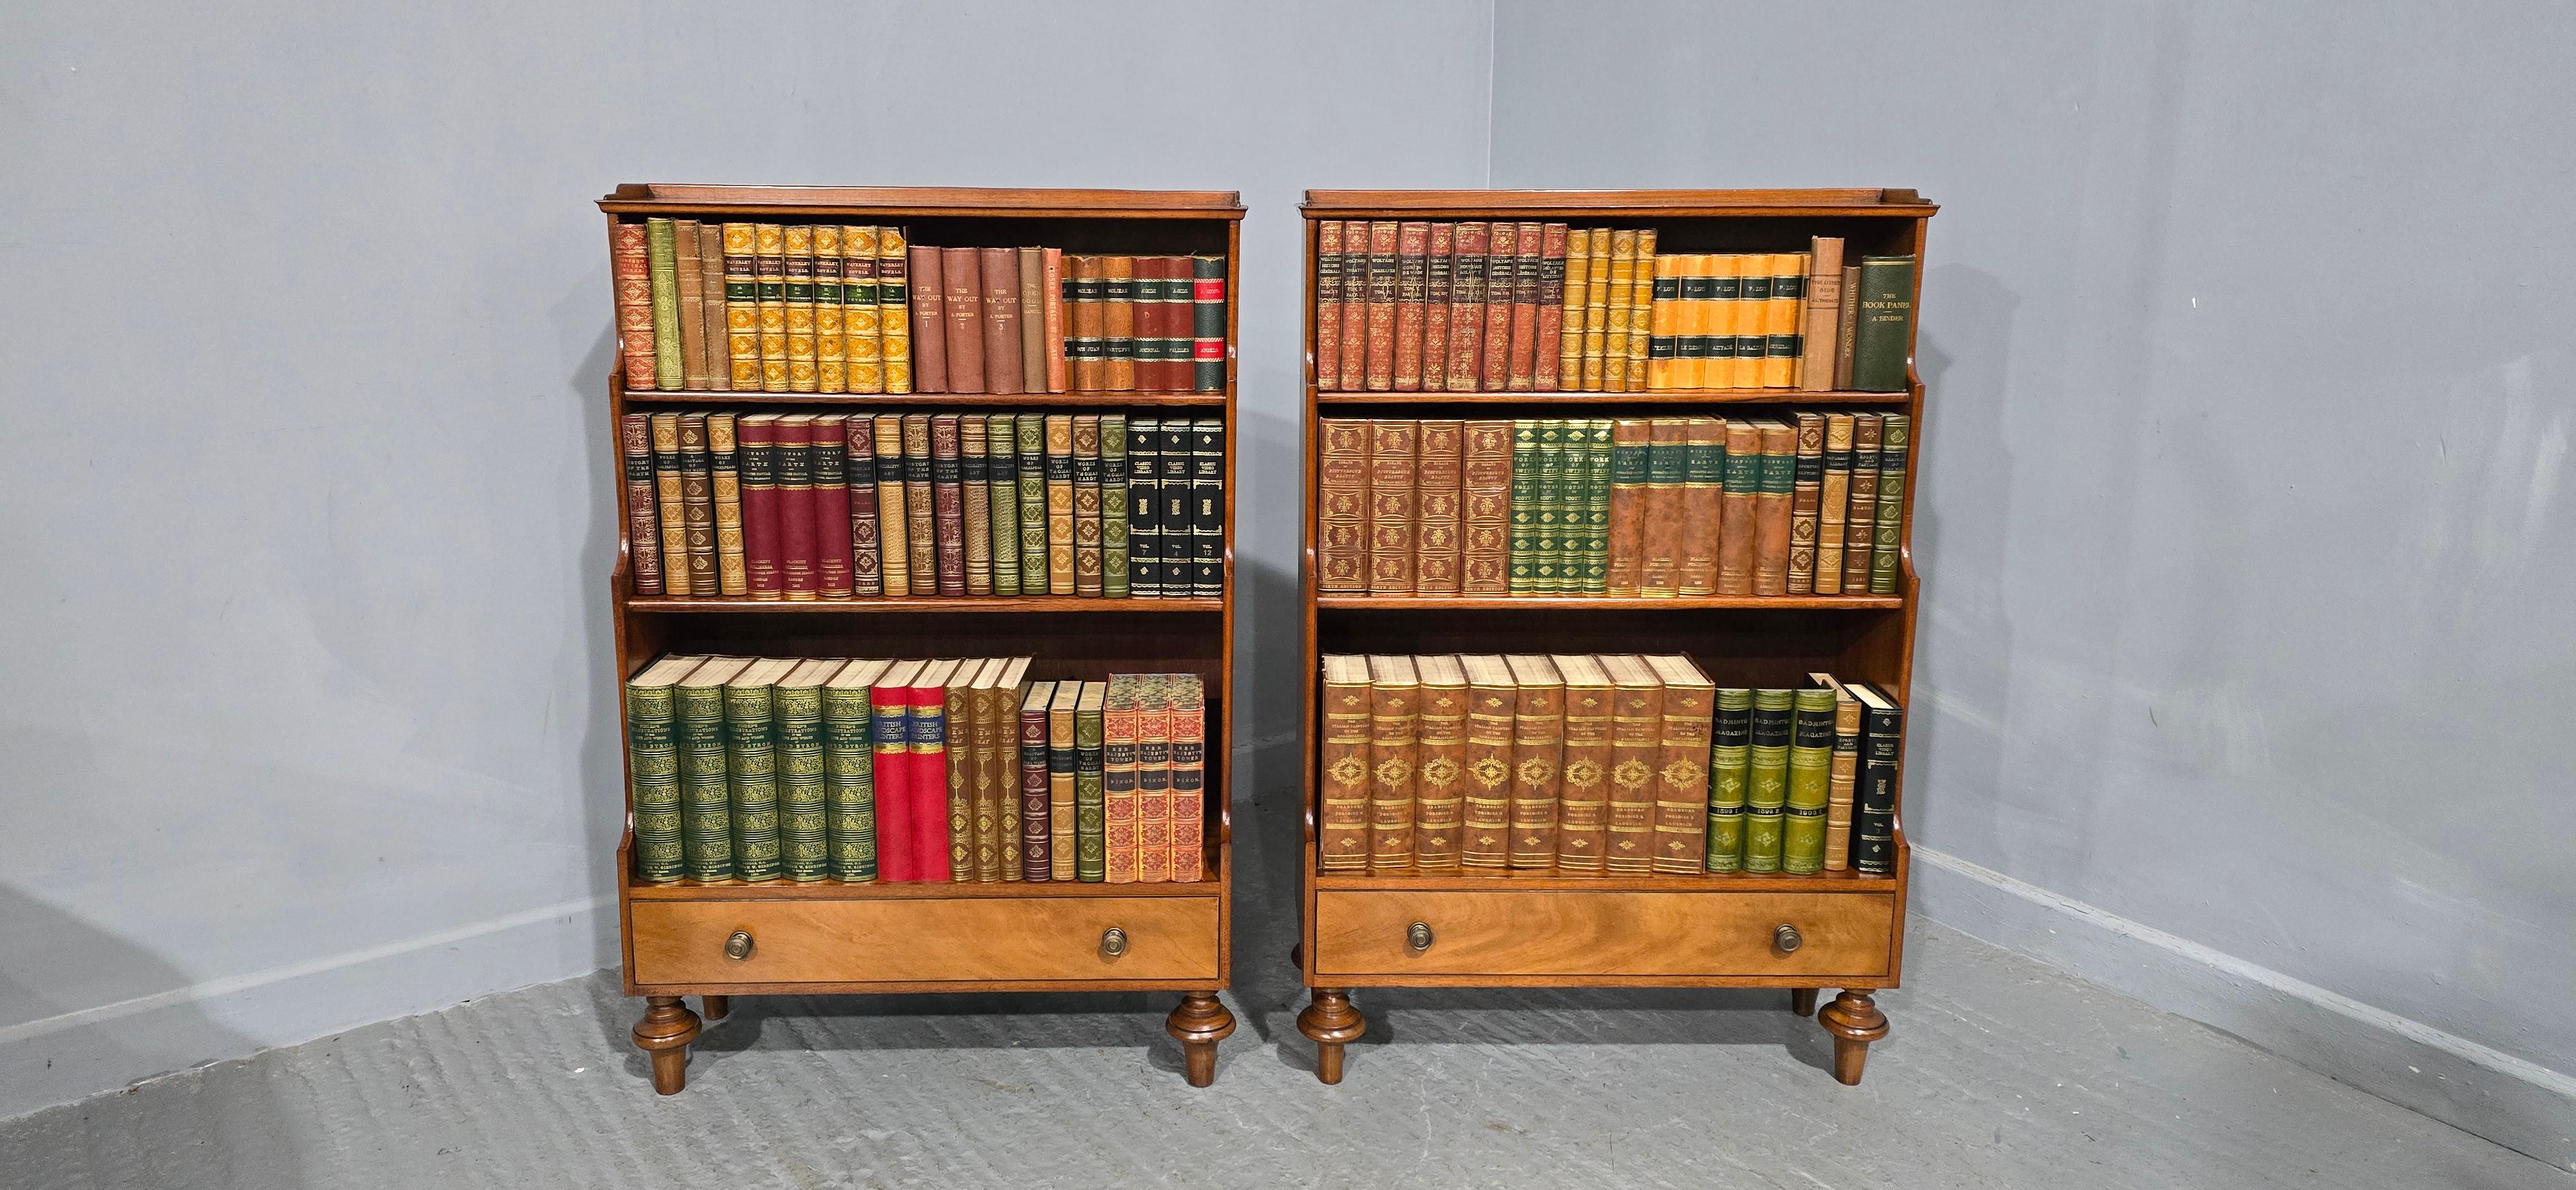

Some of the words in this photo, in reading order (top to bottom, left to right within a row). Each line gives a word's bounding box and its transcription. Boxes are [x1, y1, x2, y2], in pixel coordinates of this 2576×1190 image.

[1848, 283, 1856, 316] WHITHER
[1844, 326, 1853, 358] WONDER
[875, 726, 906, 734] NDSCAPE
